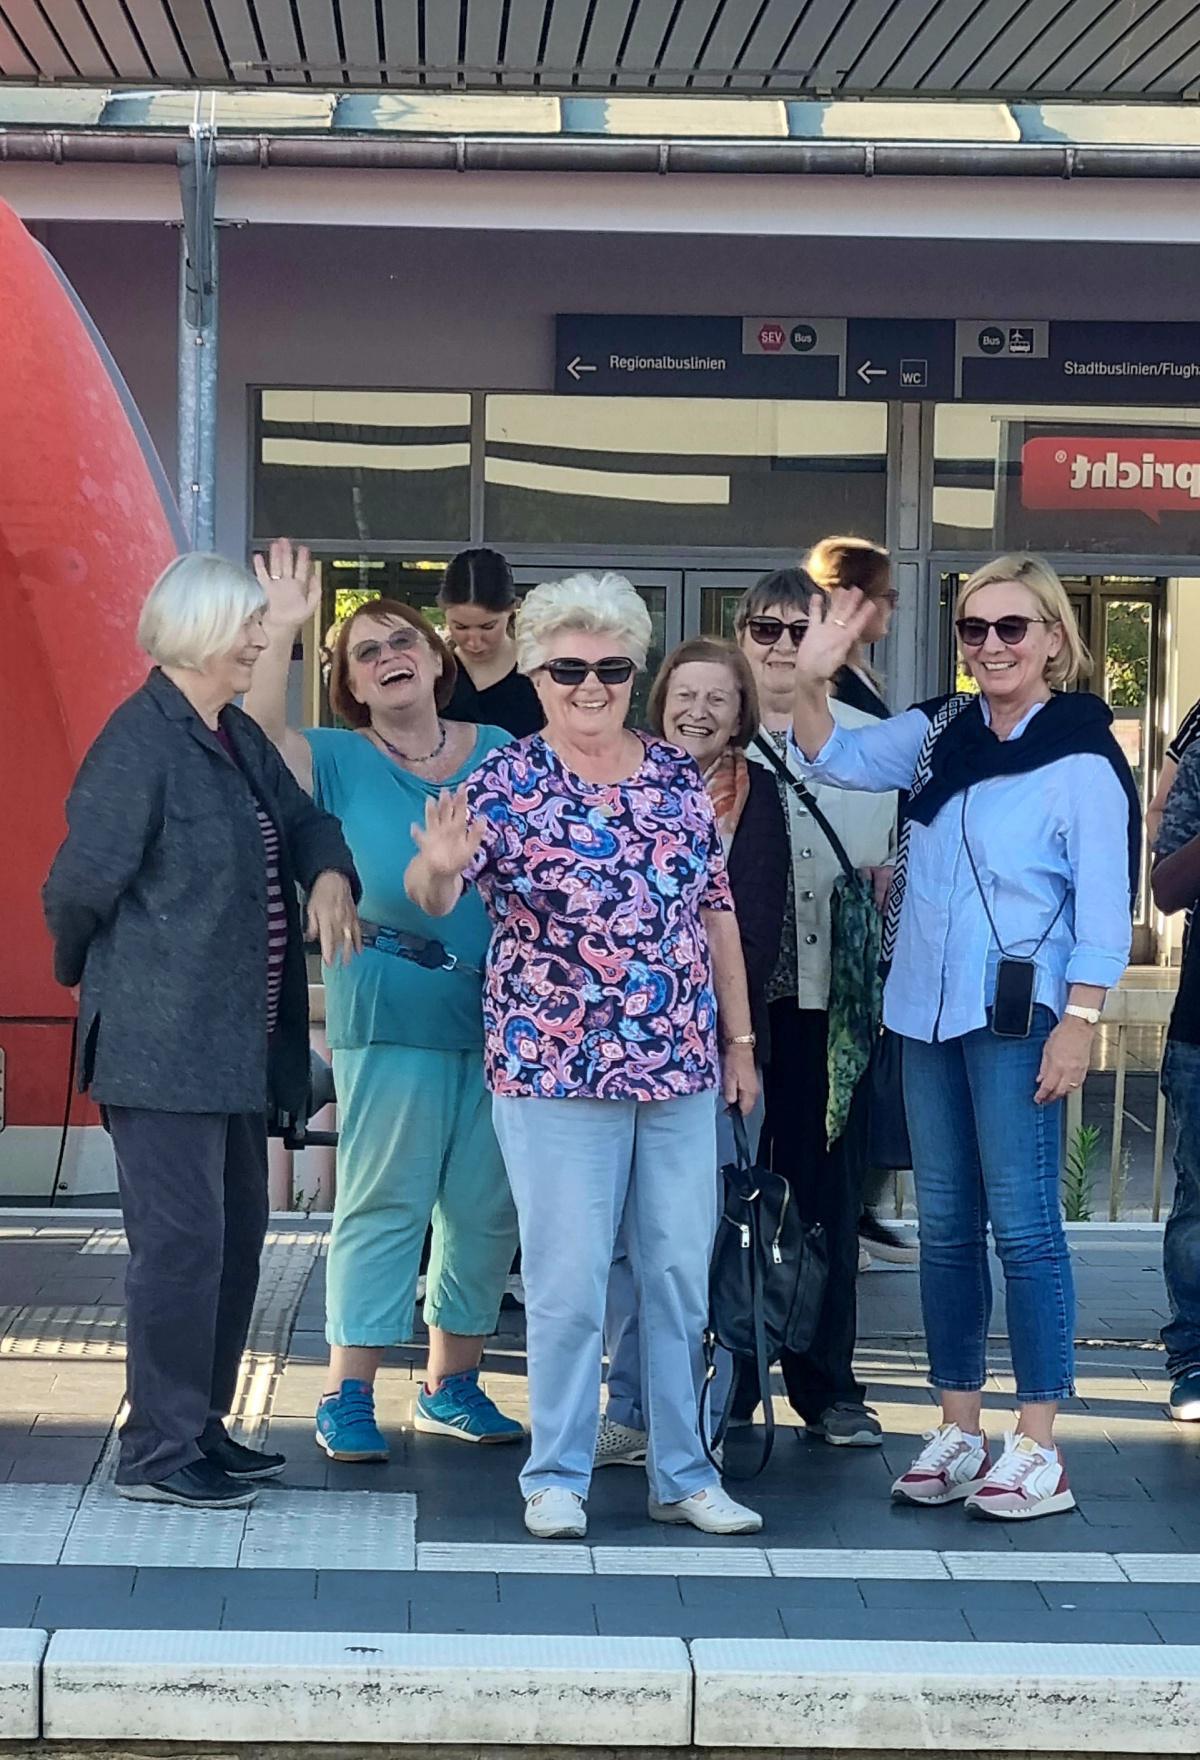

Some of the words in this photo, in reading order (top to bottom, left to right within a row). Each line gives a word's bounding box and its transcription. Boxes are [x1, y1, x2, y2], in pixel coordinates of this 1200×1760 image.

[761, 331, 783, 344] SEV
[794, 333, 812, 343] Bus
[982, 335, 1001, 346] Bus
[609, 355, 726, 371] Regionalbuslinien
[1063, 361, 1200, 378] Stadtbuslinien/Flugh
[901, 373, 921, 384] WC
